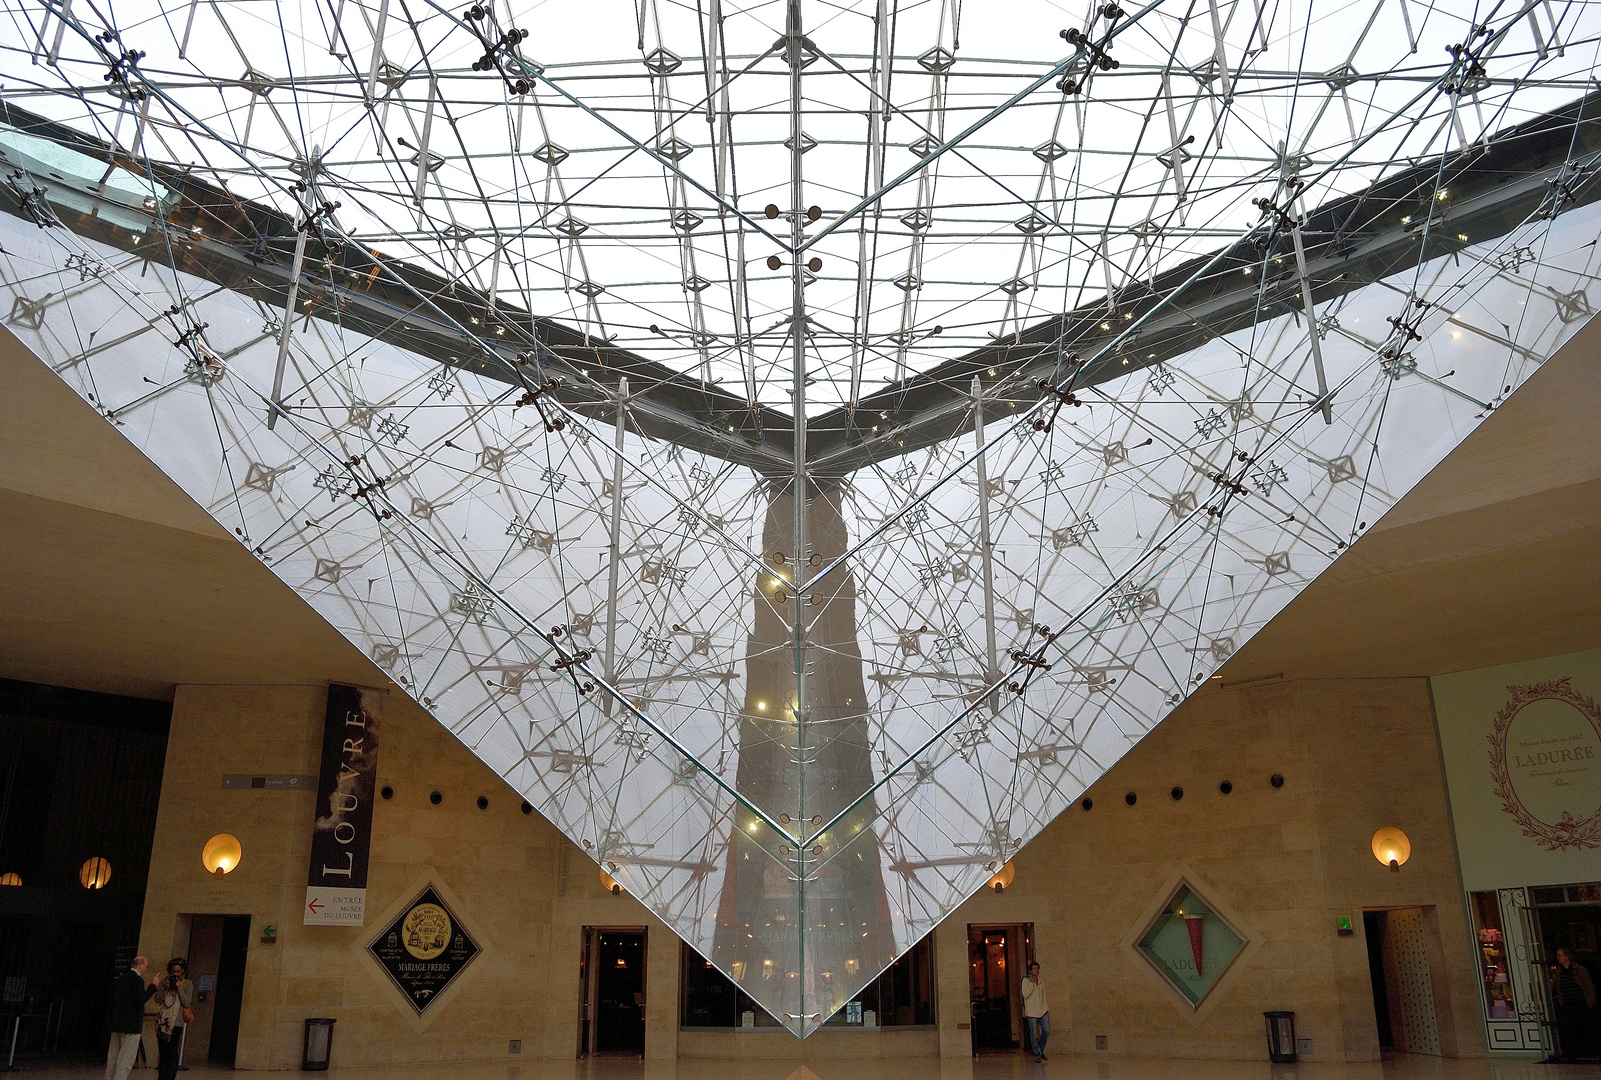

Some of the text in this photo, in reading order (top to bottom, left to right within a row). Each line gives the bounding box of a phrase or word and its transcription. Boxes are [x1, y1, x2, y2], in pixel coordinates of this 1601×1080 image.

[1514, 746, 1595, 768] LADURÉE
[1551, 777, 1573, 788] Paris
[322, 710, 366, 879] LOUVRE
[333, 896, 363, 904] ENTRÉE
[398, 961, 451, 971] MARIAGE FRÈRES
